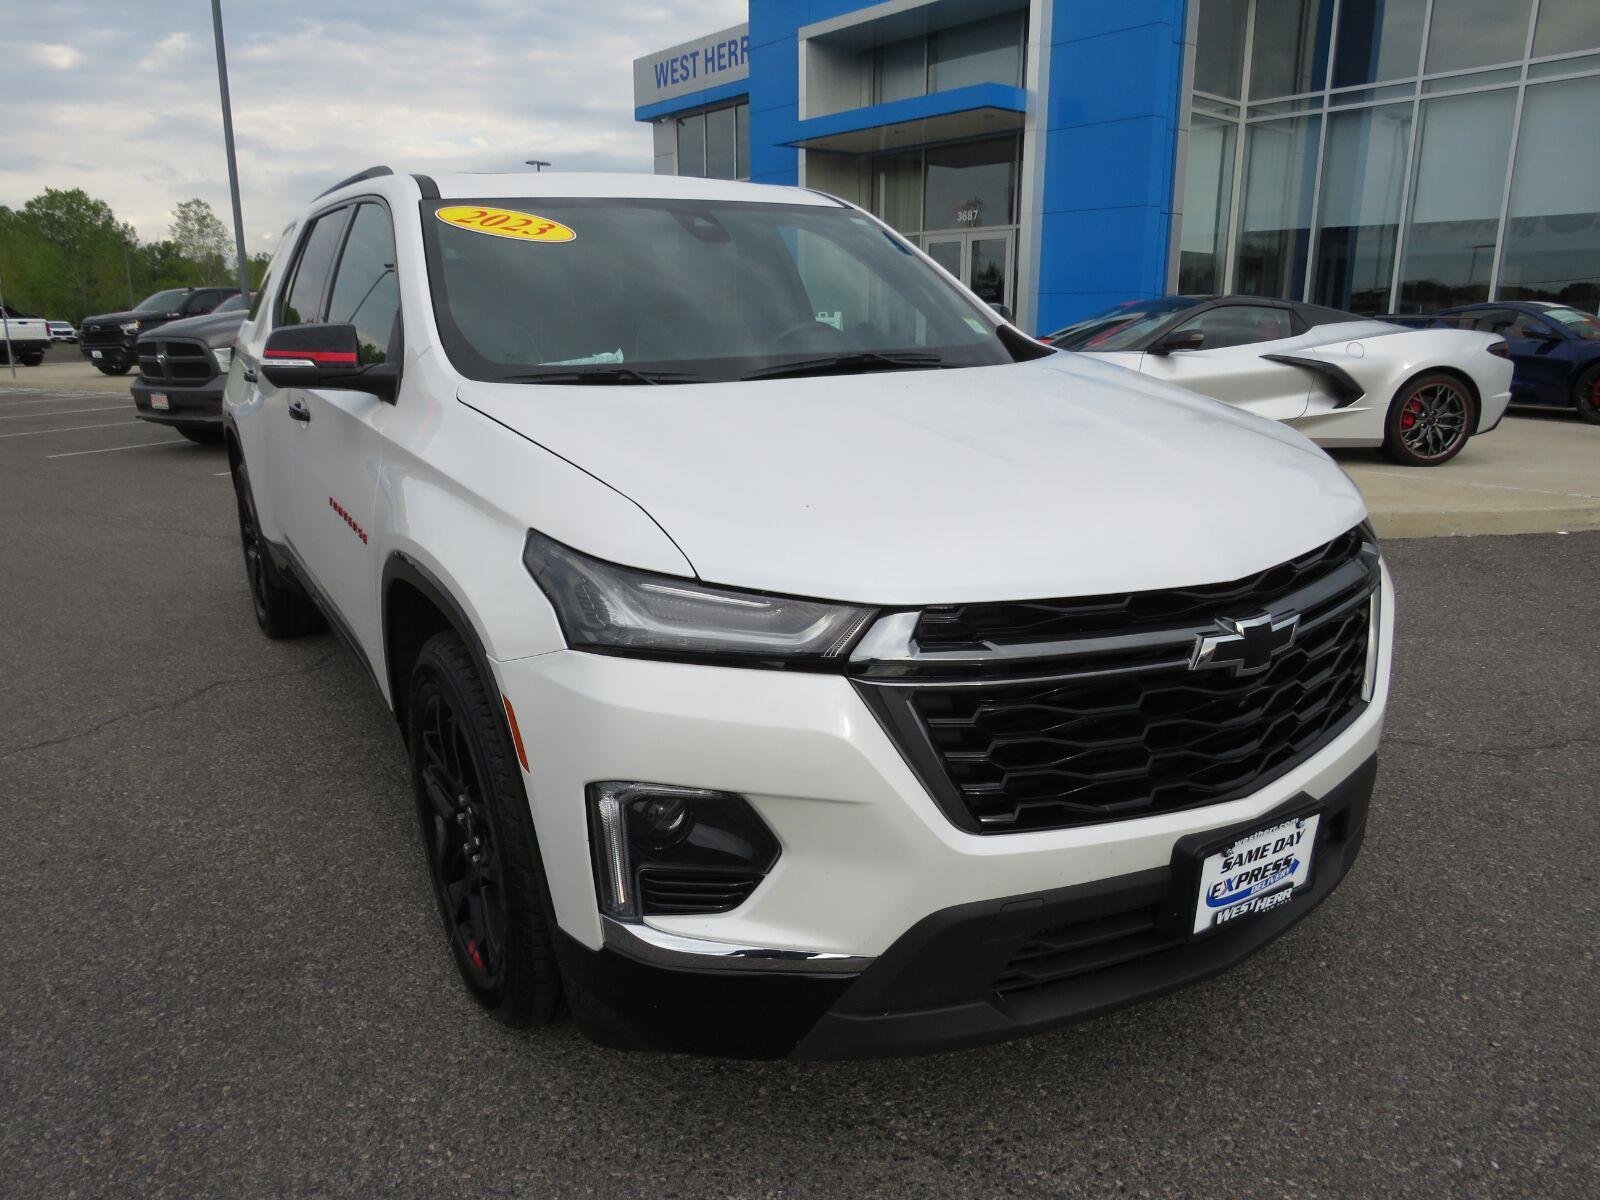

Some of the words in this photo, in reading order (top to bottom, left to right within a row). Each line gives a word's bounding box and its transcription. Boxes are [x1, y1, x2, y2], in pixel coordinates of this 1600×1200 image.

[655, 50, 700, 88] WEST
[704, 36, 749, 75] HERR
[454, 210, 556, 236] 2023
[957, 209, 979, 222] 3687
[1221, 843, 1271, 874] SAME
[1272, 829, 1306, 854] DAY
[1211, 853, 1294, 898] EXPRESS
